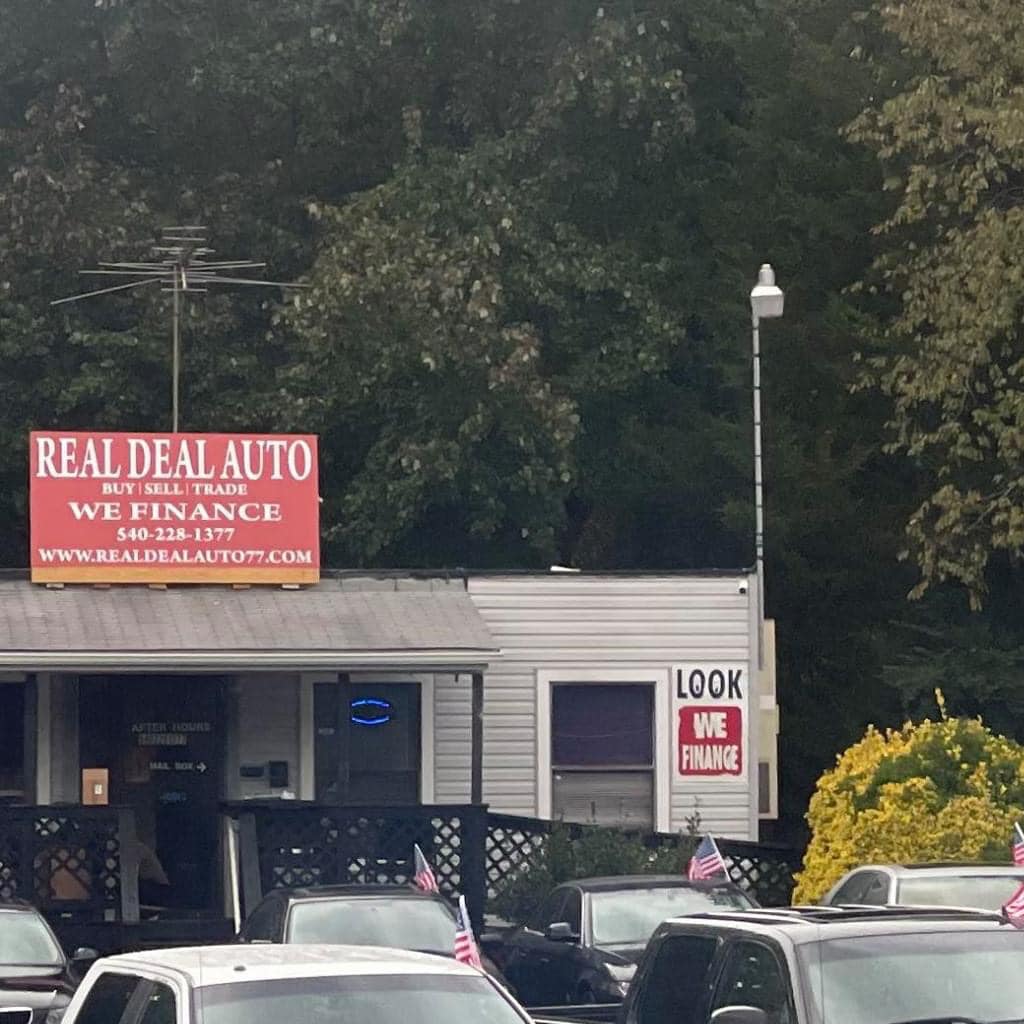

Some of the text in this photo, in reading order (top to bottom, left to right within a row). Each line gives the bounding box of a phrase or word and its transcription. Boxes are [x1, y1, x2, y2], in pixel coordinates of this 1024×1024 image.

[36, 437, 313, 481] REAL DEAL AUTO
[101, 483, 248, 496] BUY SELL TRADE
[68, 502, 282, 522] WE FINANCE
[116, 527, 236, 542] 540-228-1377
[38, 548, 313, 565] WWW.REALDEALAUTO77.COM
[677, 669, 743, 699] LOOK
[693, 711, 728, 739] WE
[681, 744, 739, 771] FINANCE
